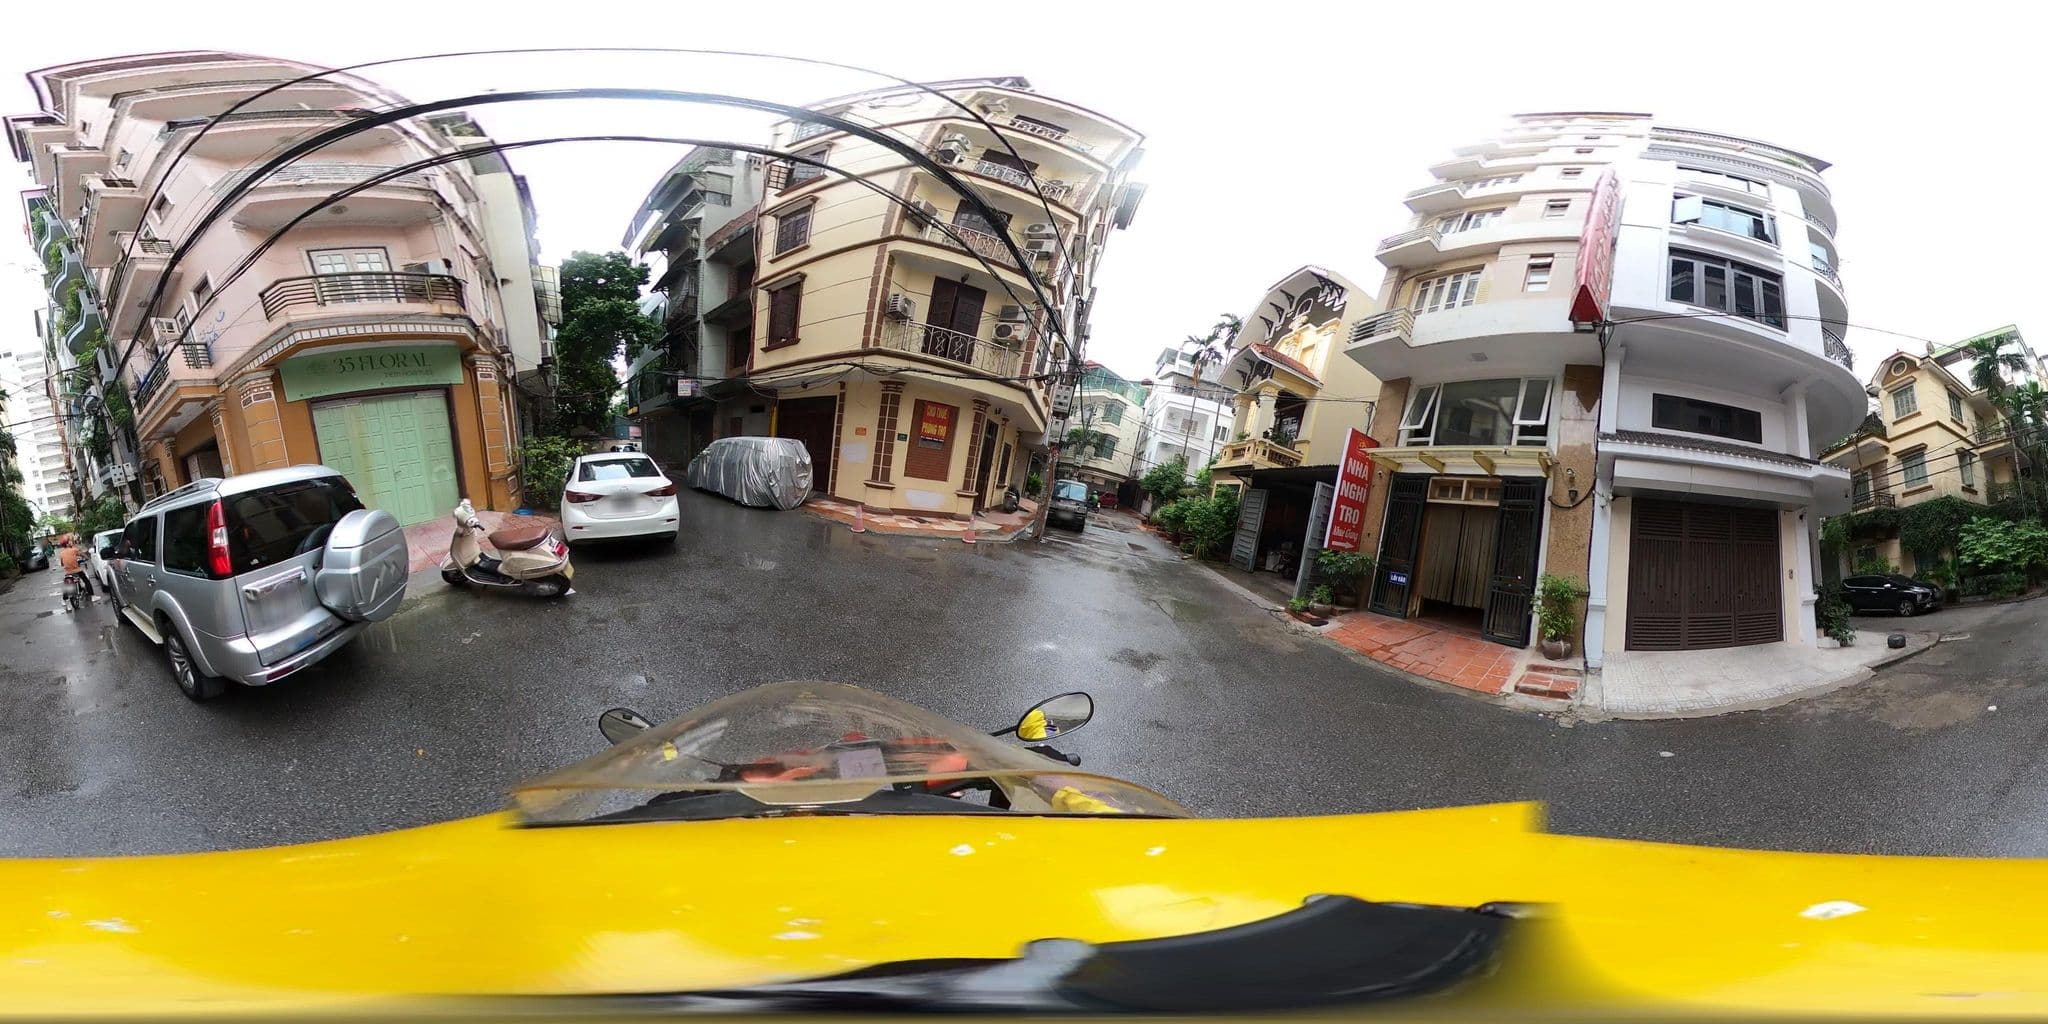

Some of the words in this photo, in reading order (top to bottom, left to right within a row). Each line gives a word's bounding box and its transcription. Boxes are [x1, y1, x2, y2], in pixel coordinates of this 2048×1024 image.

[333, 357, 355, 374] 35
[359, 352, 432, 371] FLORAL
[1347, 457, 1369, 481] NHÀ
[1340, 480, 1369, 504] NGHỈ
[1340, 504, 1360, 528] TRỌ
